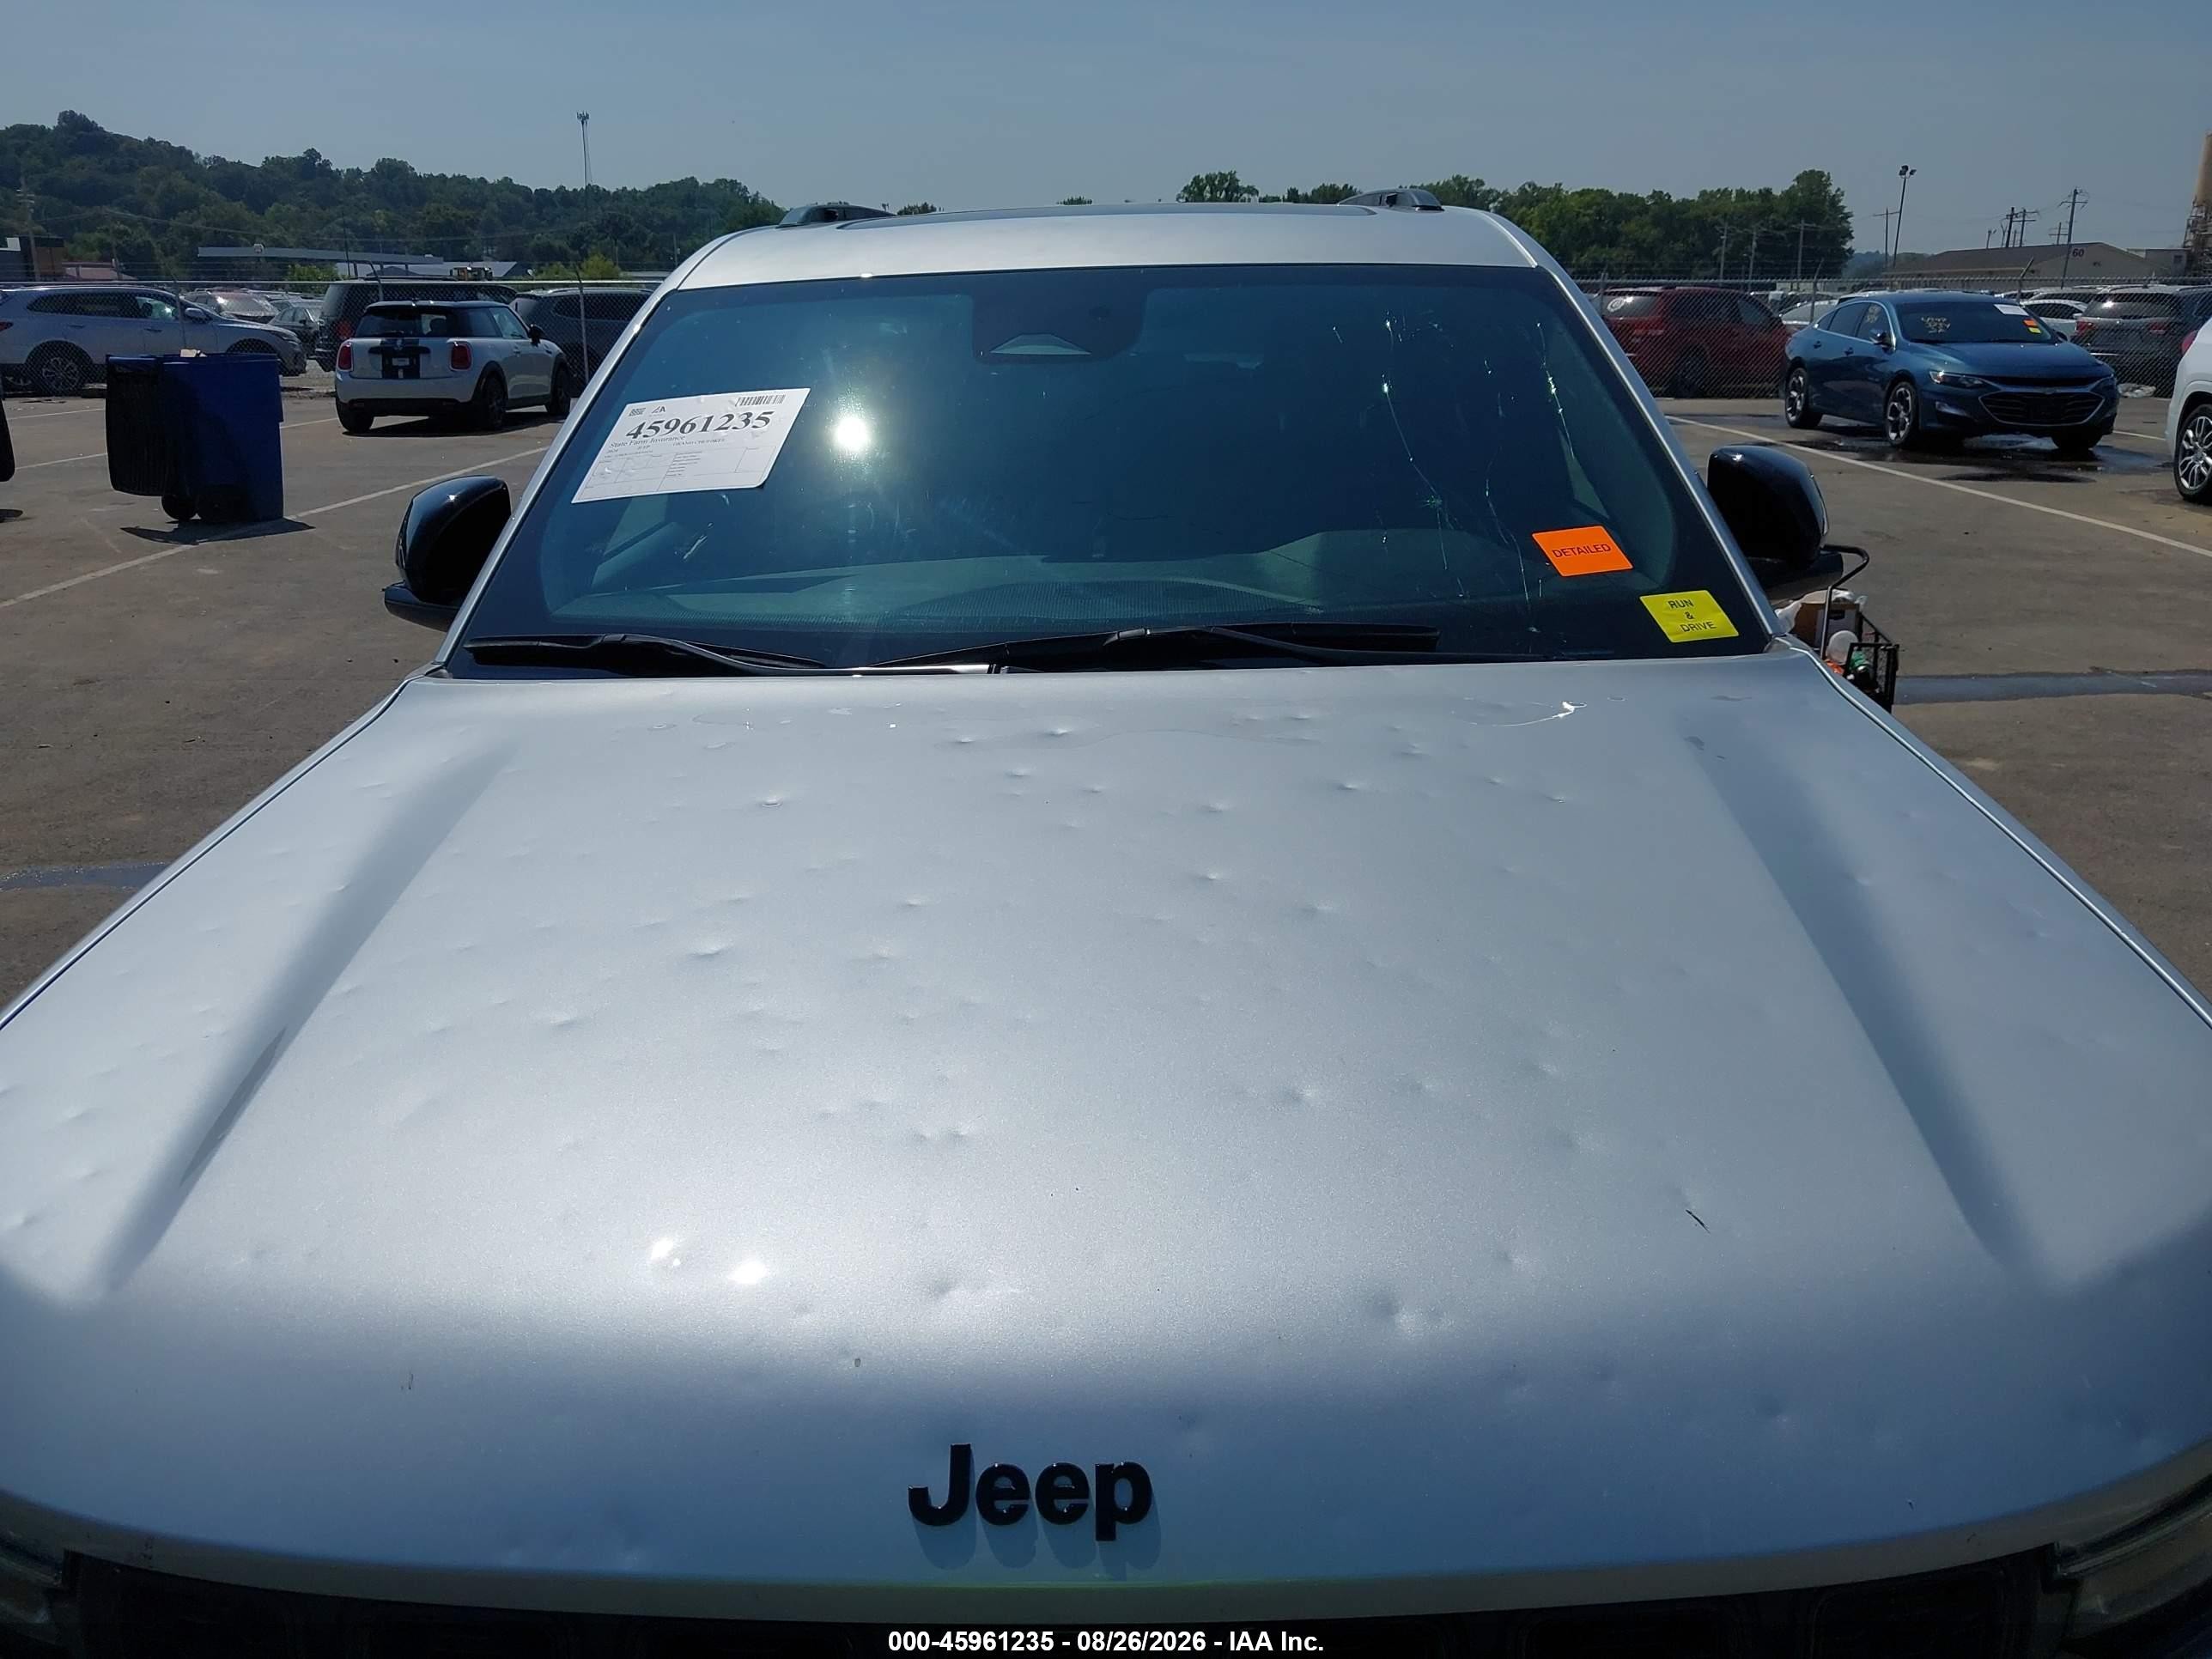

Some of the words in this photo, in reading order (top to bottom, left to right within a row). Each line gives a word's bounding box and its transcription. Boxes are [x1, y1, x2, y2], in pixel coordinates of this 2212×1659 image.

[625, 410, 775, 439] 45961235
[1553, 543, 1612, 558] DETAILED
[1668, 599, 1694, 610] RUN
[1685, 611, 1694, 620] &
[1680, 621, 1717, 633] DRIVE
[908, 1443, 1153, 1542] Jeep
